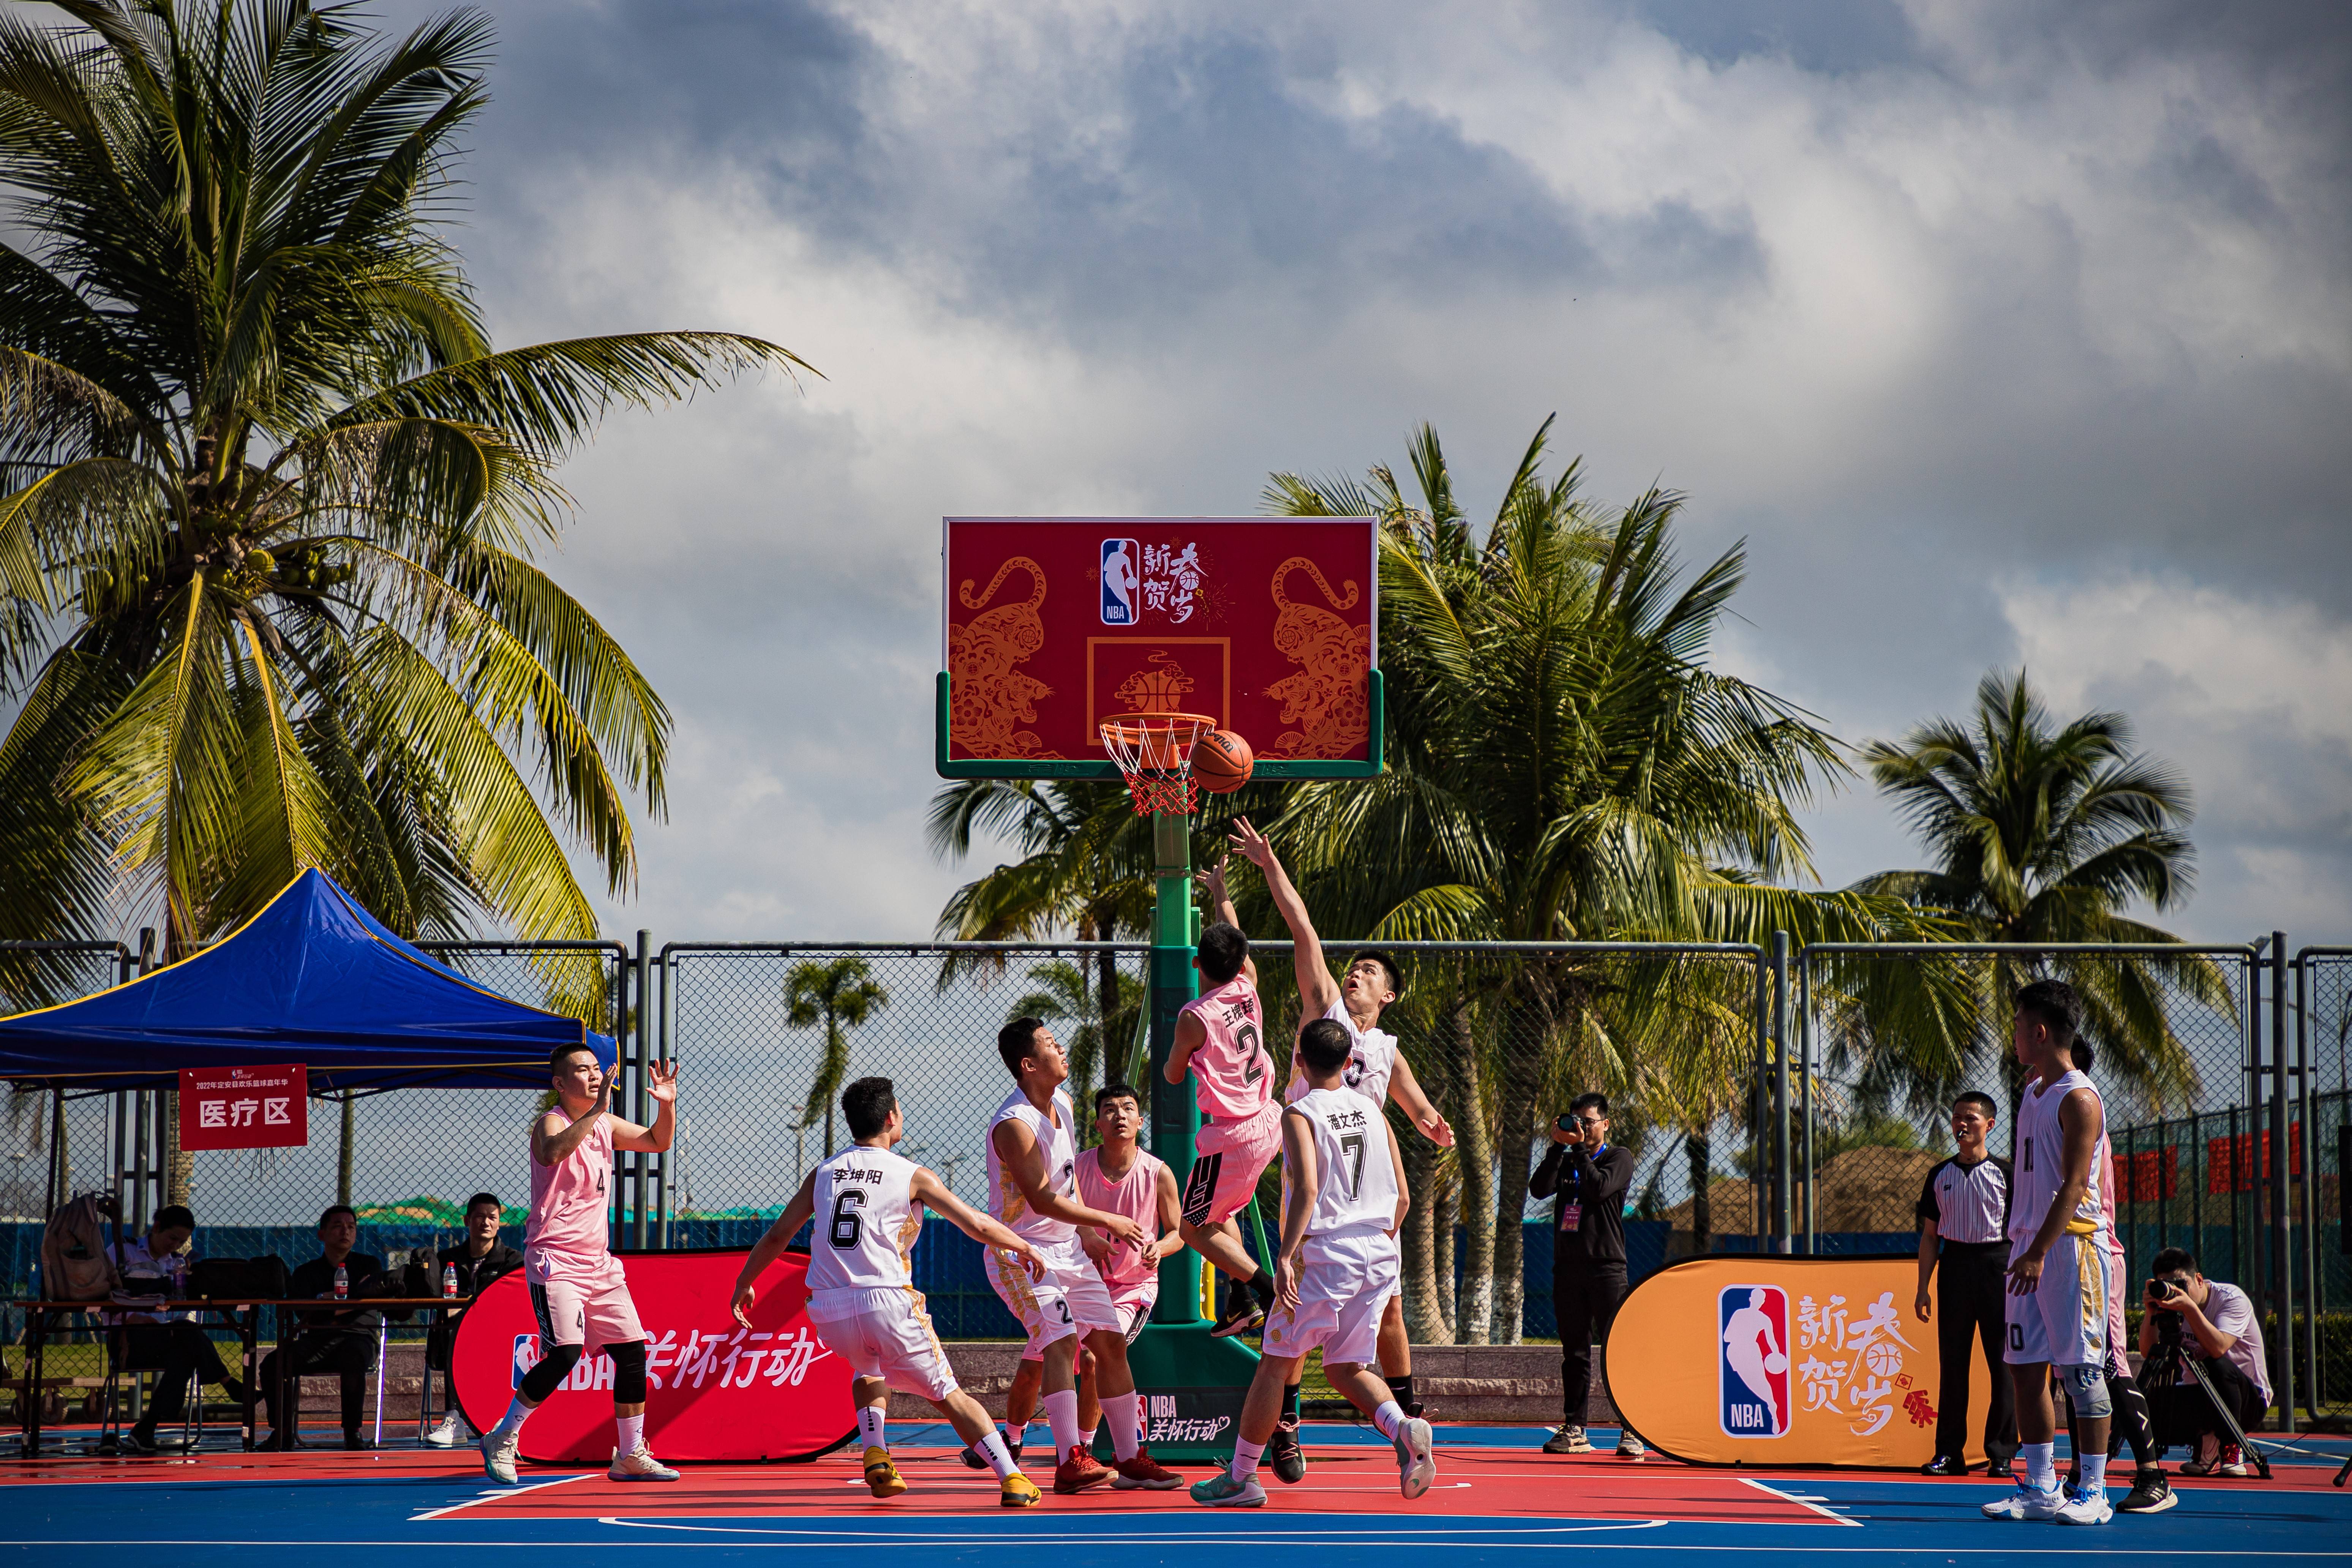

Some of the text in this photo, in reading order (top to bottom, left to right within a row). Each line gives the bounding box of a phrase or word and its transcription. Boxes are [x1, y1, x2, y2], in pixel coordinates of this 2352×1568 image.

[1107, 606, 1125, 619] NBA
[1234, 1021, 1264, 1088] 2
[196, 1078, 288, 1090] 2022年定安县欢乐篮球嘉年华
[1344, 1057, 1366, 1089] 3
[200, 1097, 291, 1127] 医疗区
[1327, 1110, 1367, 1131] 潘文杰
[832, 1168, 883, 1185] 李坤阳
[1063, 1162, 1075, 1197] 2
[1340, 1131, 1367, 1202] 7
[596, 1167, 606, 1198] 4
[828, 1188, 869, 1251] 6
[575, 1310, 583, 1334] 4
[1055, 1299, 1074, 1325] 2
[2006, 1322, 2025, 1352] 0
[557, 1326, 815, 1391] BA 关怀行动
[1151, 1396, 1177, 1418] NBA
[1798, 1354, 1893, 1436] 贺岁
[1148, 1418, 1218, 1442] 关怀行动
[1731, 1404, 1764, 1427] NBA
